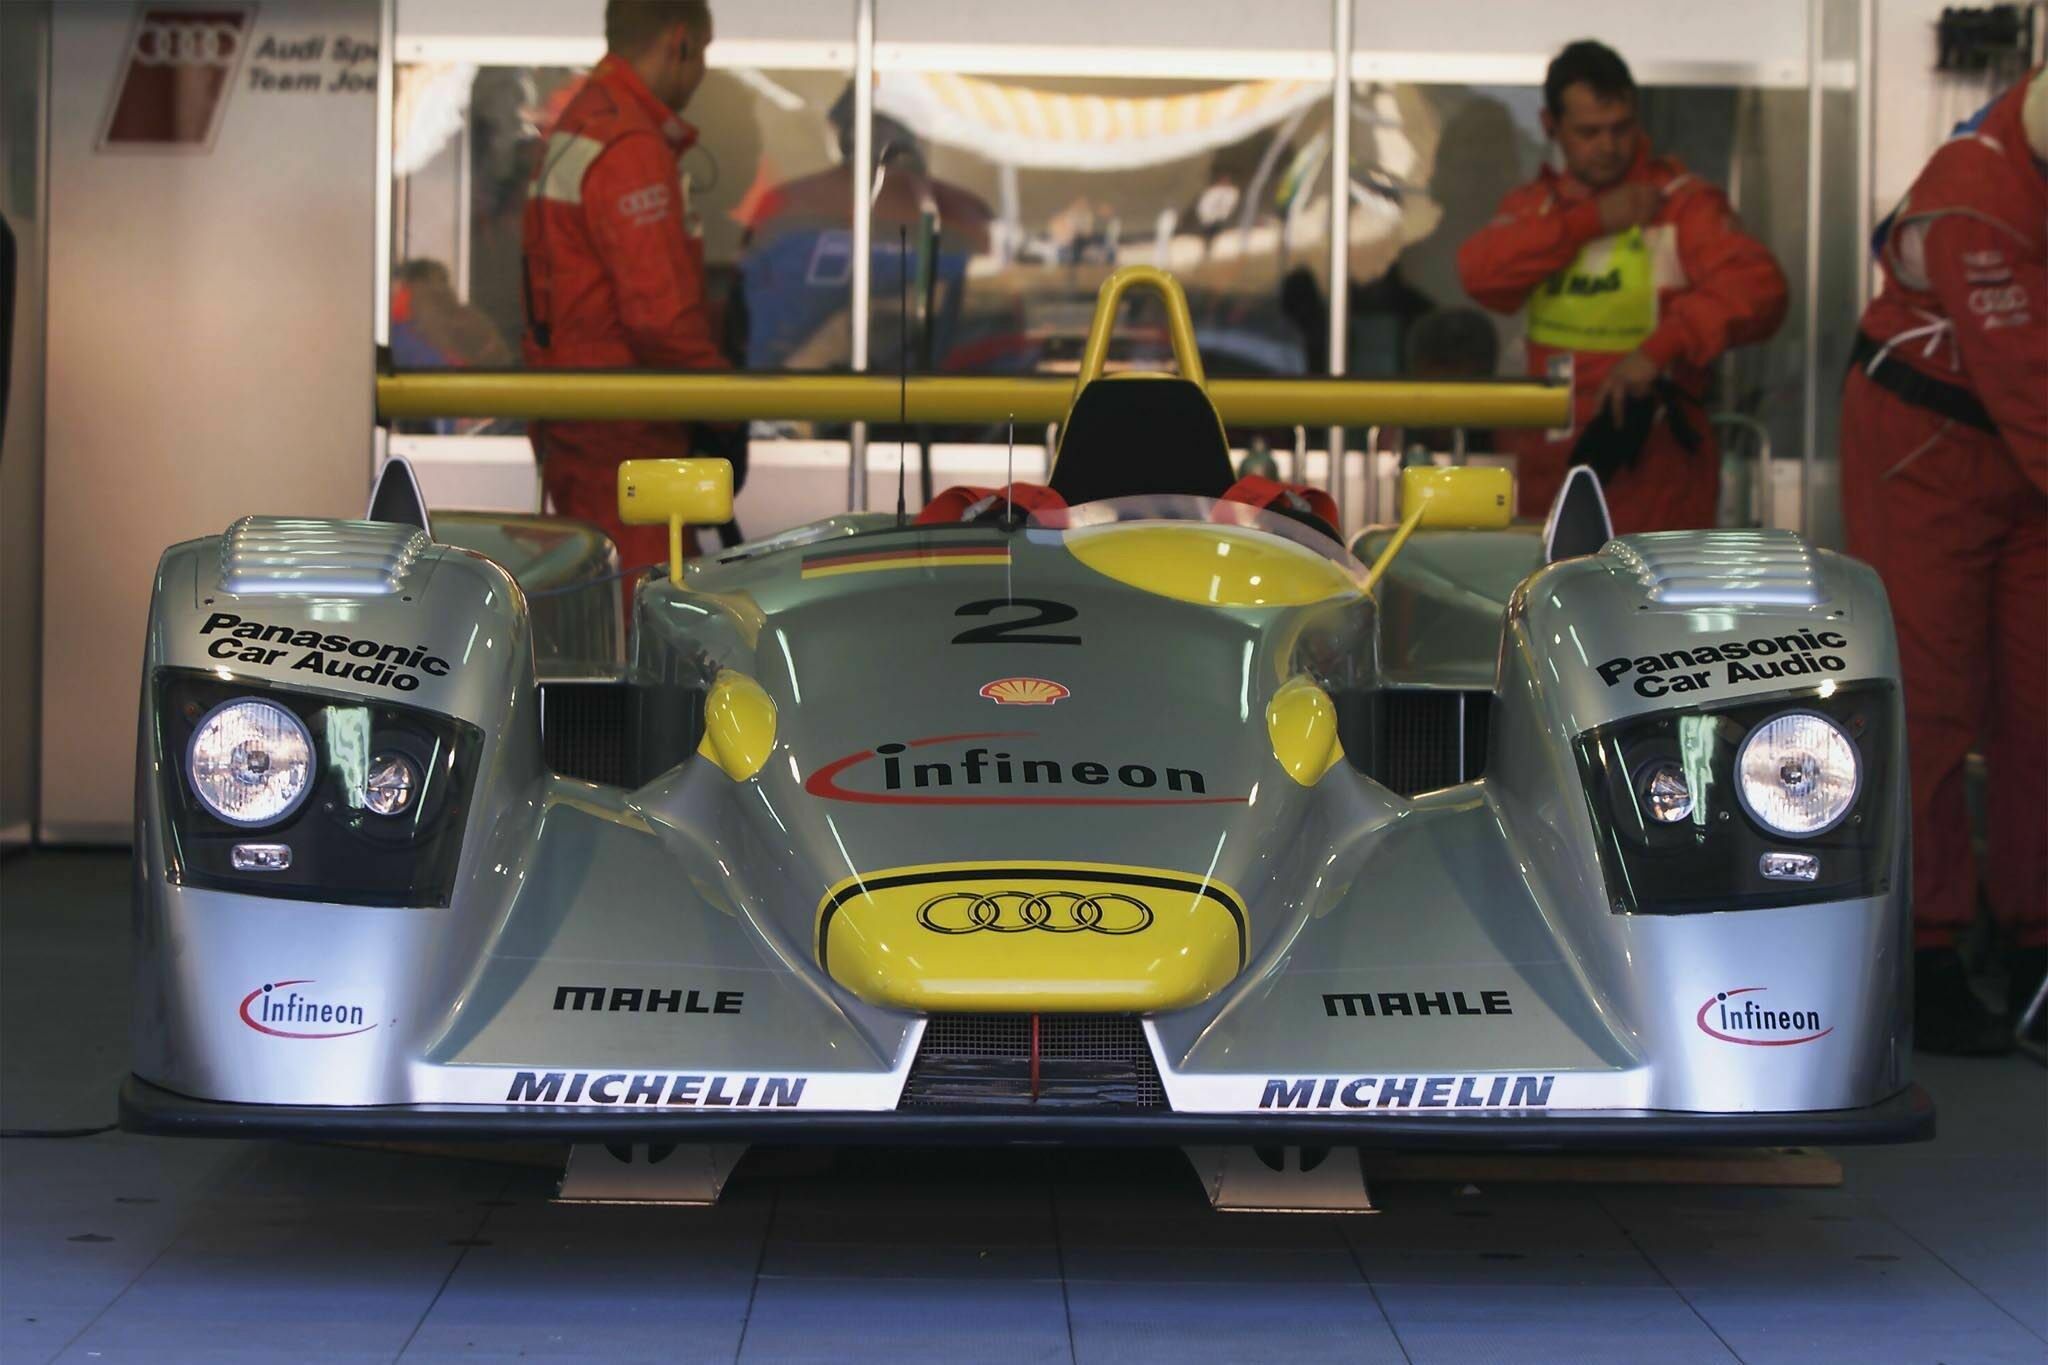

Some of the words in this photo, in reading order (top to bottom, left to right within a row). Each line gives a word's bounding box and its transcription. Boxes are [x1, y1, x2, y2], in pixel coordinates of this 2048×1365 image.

[256, 36, 324, 61] Audi
[249, 66, 322, 92] Team
[951, 598, 1082, 645] 2
[200, 612, 450, 676] Panasonic
[207, 637, 288, 666] Car
[291, 651, 420, 692] Audio
[1596, 628, 1848, 688] Panasonic
[1633, 670, 1712, 698] Car
[1727, 652, 1847, 685] Audio
[876, 743, 1206, 794] infineon
[262, 983, 364, 1026] infineon
[552, 986, 745, 1015] MAHLE
[1322, 991, 1513, 1017] MAHLE
[1717, 992, 1821, 1031] infineon
[506, 1071, 807, 1108] MICHELIN
[1259, 1075, 1556, 1109] MICHELIN
